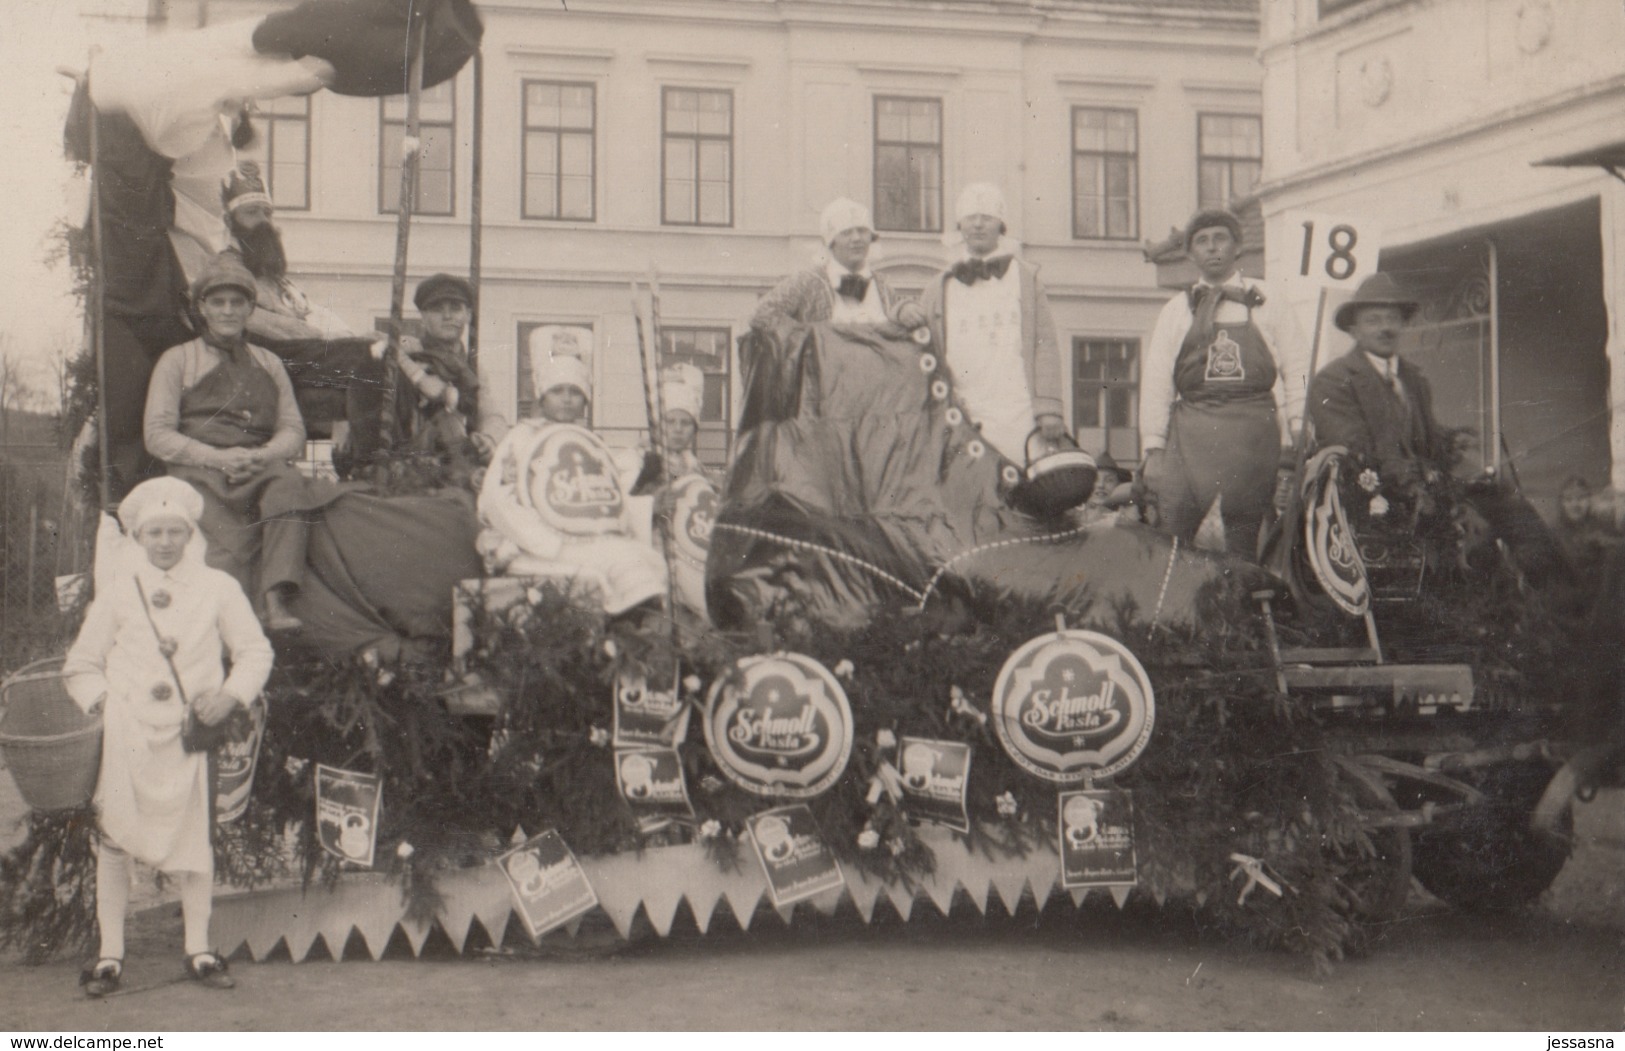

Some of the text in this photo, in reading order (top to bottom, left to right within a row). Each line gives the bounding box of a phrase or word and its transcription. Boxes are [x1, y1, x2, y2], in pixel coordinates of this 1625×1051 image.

[1301, 221, 1358, 280] 18
[730, 704, 817, 743] Schmoll
[1023, 680, 1116, 728] Schmoll
[1056, 711, 1100, 730] Pasta
